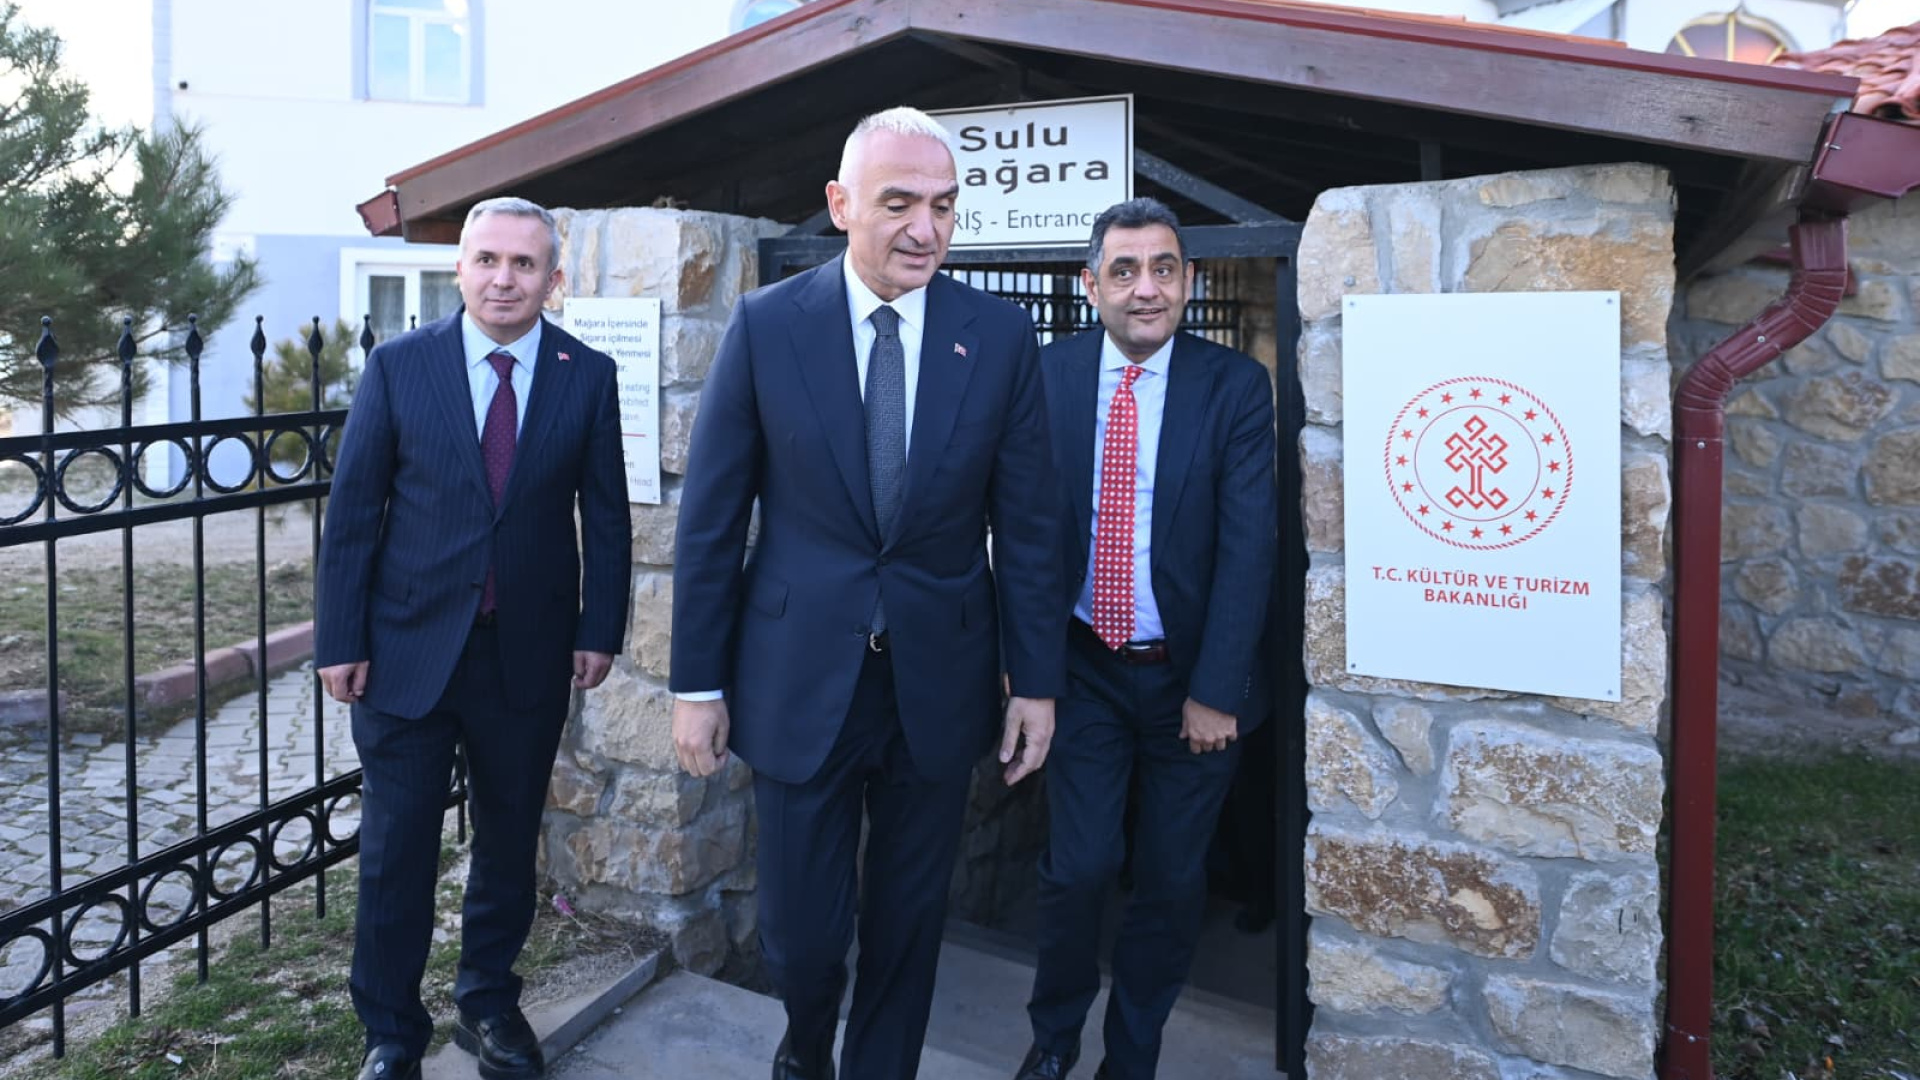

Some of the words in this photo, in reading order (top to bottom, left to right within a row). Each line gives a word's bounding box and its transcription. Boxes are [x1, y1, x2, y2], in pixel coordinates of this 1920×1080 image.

[960, 122, 1068, 152] Sulu
[965, 159, 1109, 194] ağara
[574, 318, 606, 330] Mağara
[580, 333, 607, 344] Sigara
[616, 349, 651, 359] Yenmesi
[625, 383, 650, 394] eating
[1372, 566, 1402, 582] T.C.
[1407, 567, 1479, 588] KÜLTÜR
[1484, 575, 1508, 589] VE
[1513, 576, 1590, 596] TURİZM
[1424, 588, 1528, 609] BAKANLIĞI
